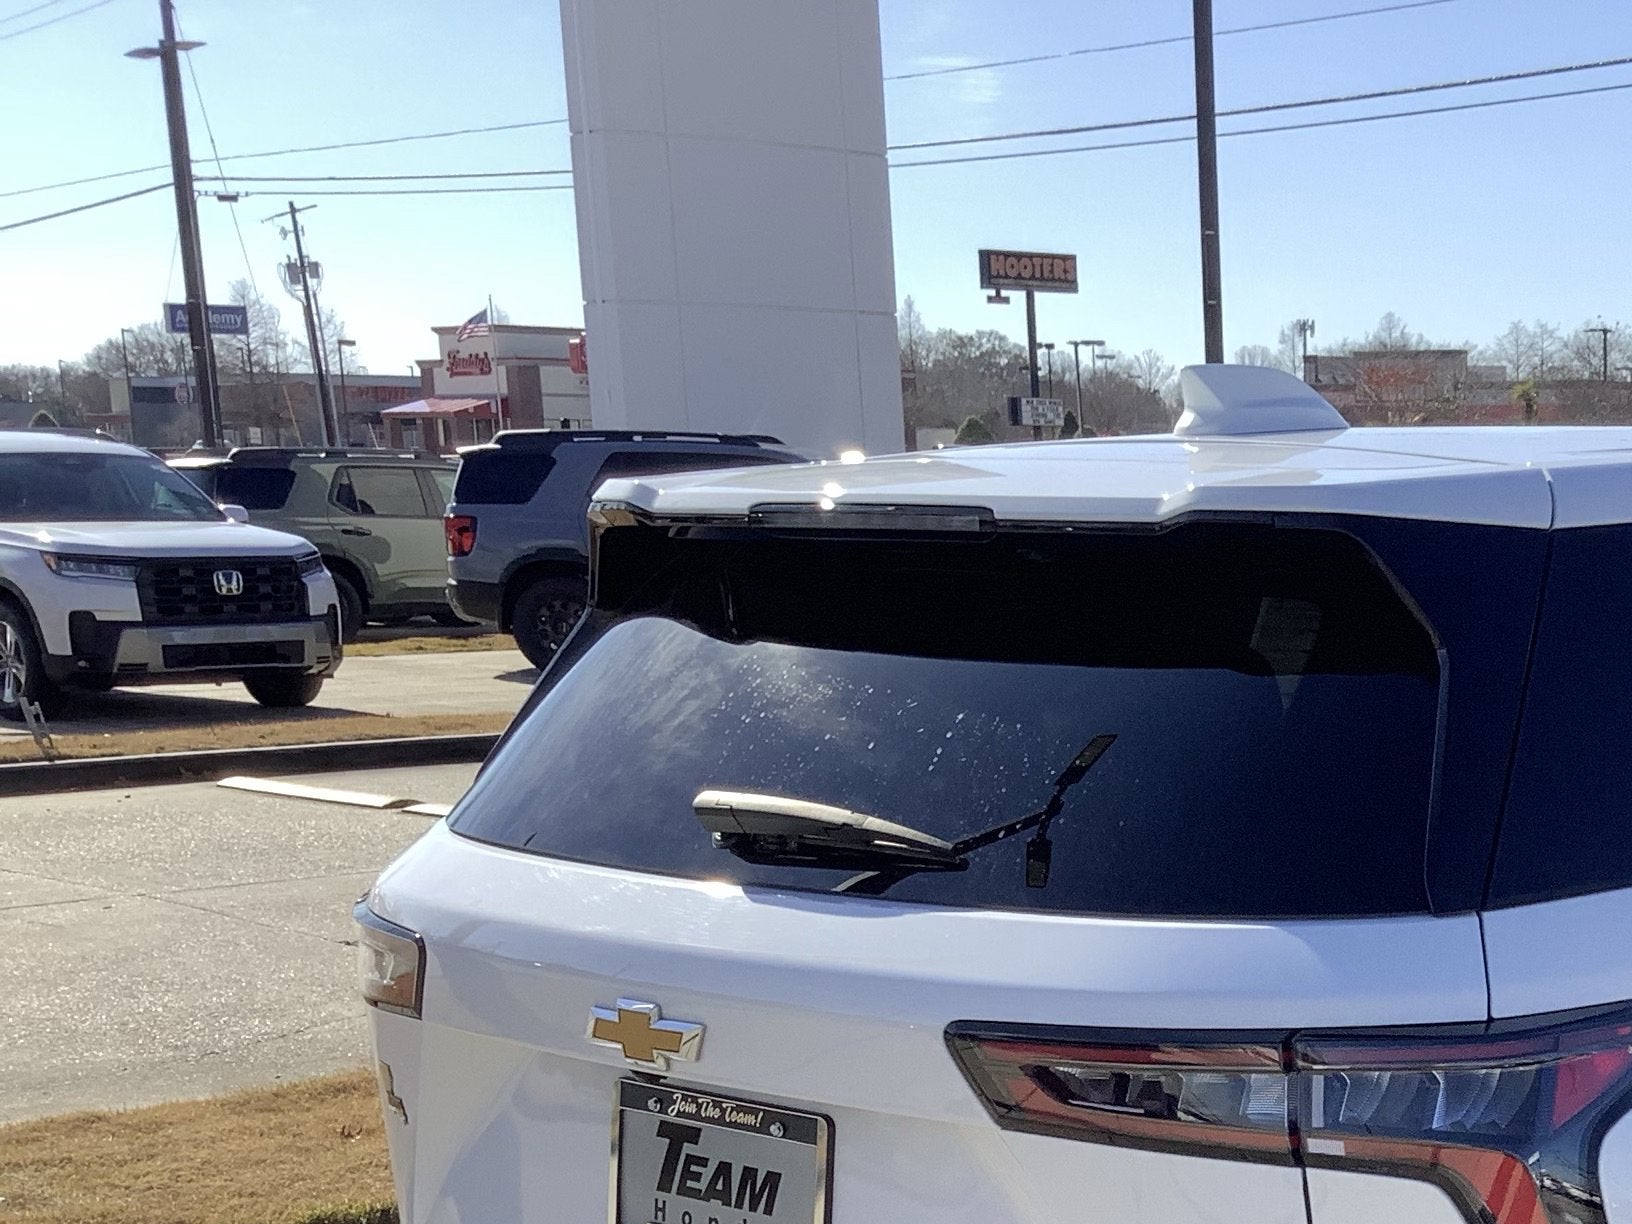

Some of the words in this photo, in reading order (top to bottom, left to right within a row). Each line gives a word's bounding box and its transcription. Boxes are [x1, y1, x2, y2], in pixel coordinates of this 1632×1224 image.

[990, 254, 1074, 281] HOOTERS
[667, 1093, 697, 1116] Join
[698, 1098, 721, 1118] The
[722, 1103, 764, 1127] Team!
[656, 1119, 782, 1216] TEAM
